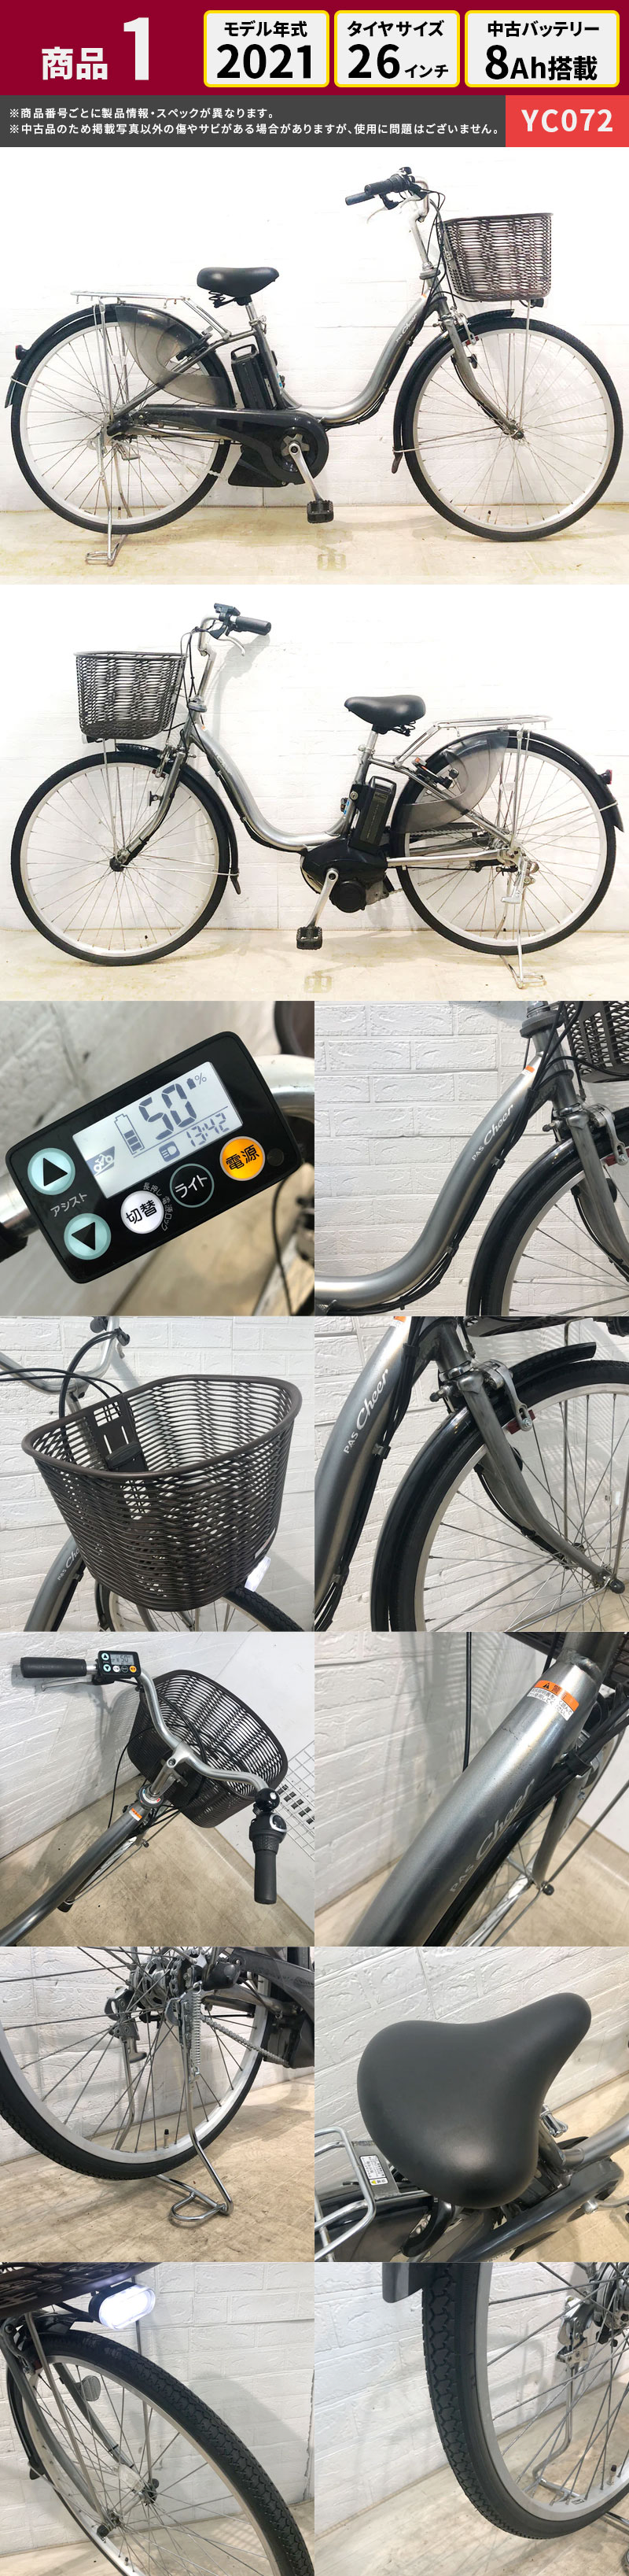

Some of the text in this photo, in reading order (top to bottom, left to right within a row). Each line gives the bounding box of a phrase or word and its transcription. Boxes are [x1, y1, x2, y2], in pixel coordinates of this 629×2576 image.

[138, 1083, 197, 1140] 50
[186, 1113, 230, 1147] 13:42
[472, 1104, 513, 1161] PAS Cheer
[226, 1144, 260, 1171] 電源
[175, 1174, 208, 1198] ライト
[50, 1192, 88, 1217] アシスト
[126, 1200, 157, 1224] 切替
[143, 1182, 174, 1231] 長押し 電源ロック
[344, 1368, 388, 1454] PAS Cheer
[57, 1548, 79, 1581] PAS Che
[450, 1778, 535, 1892] PAS Cheer
